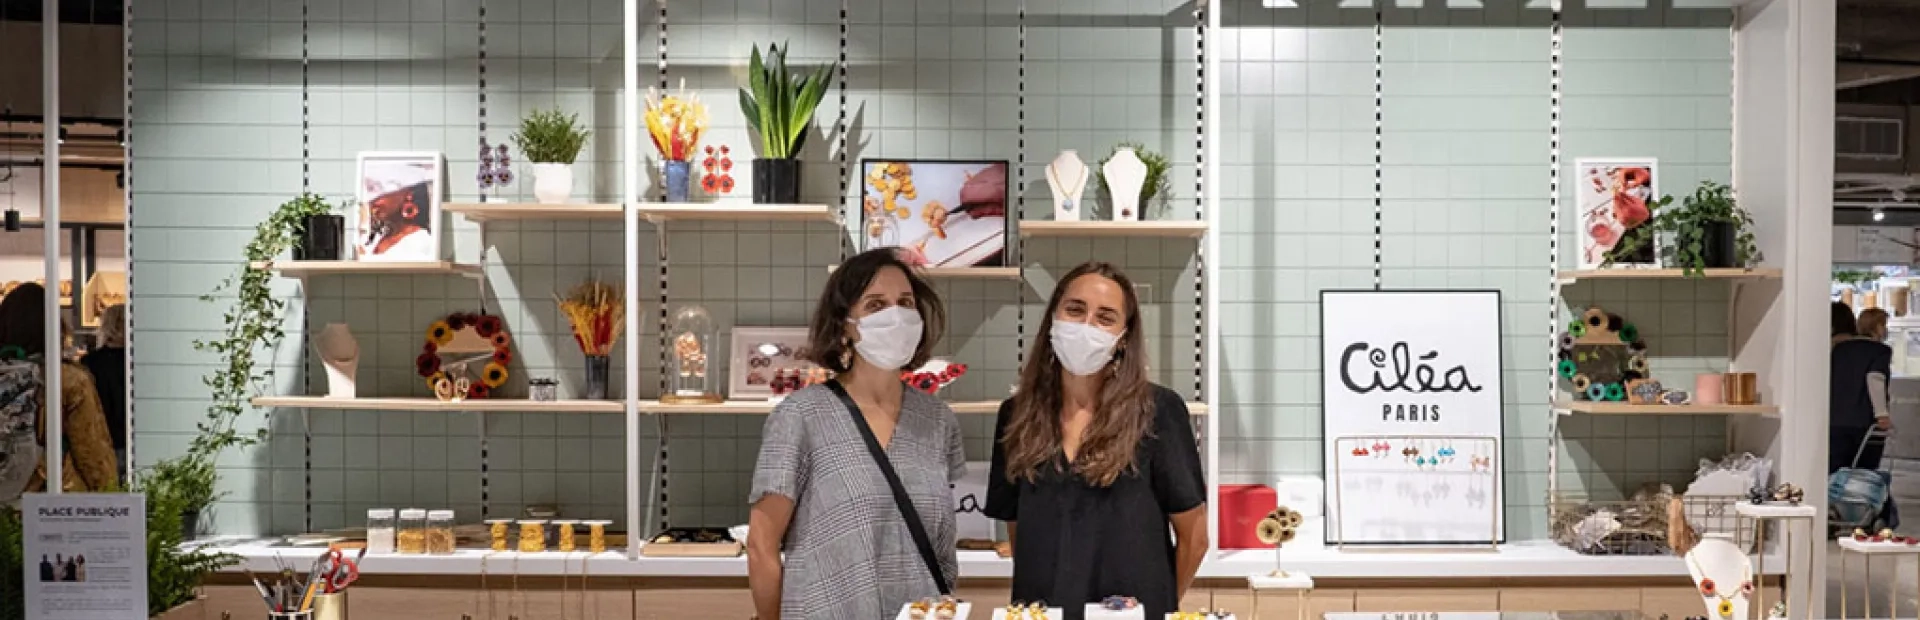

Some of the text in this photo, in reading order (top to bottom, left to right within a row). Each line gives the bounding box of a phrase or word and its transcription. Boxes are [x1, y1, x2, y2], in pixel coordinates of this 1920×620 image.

[1340, 341, 1483, 394] Ciléa
[1382, 404, 1440, 421] PARIS
[38, 506, 129, 518] PLACE PUBLIQUE
